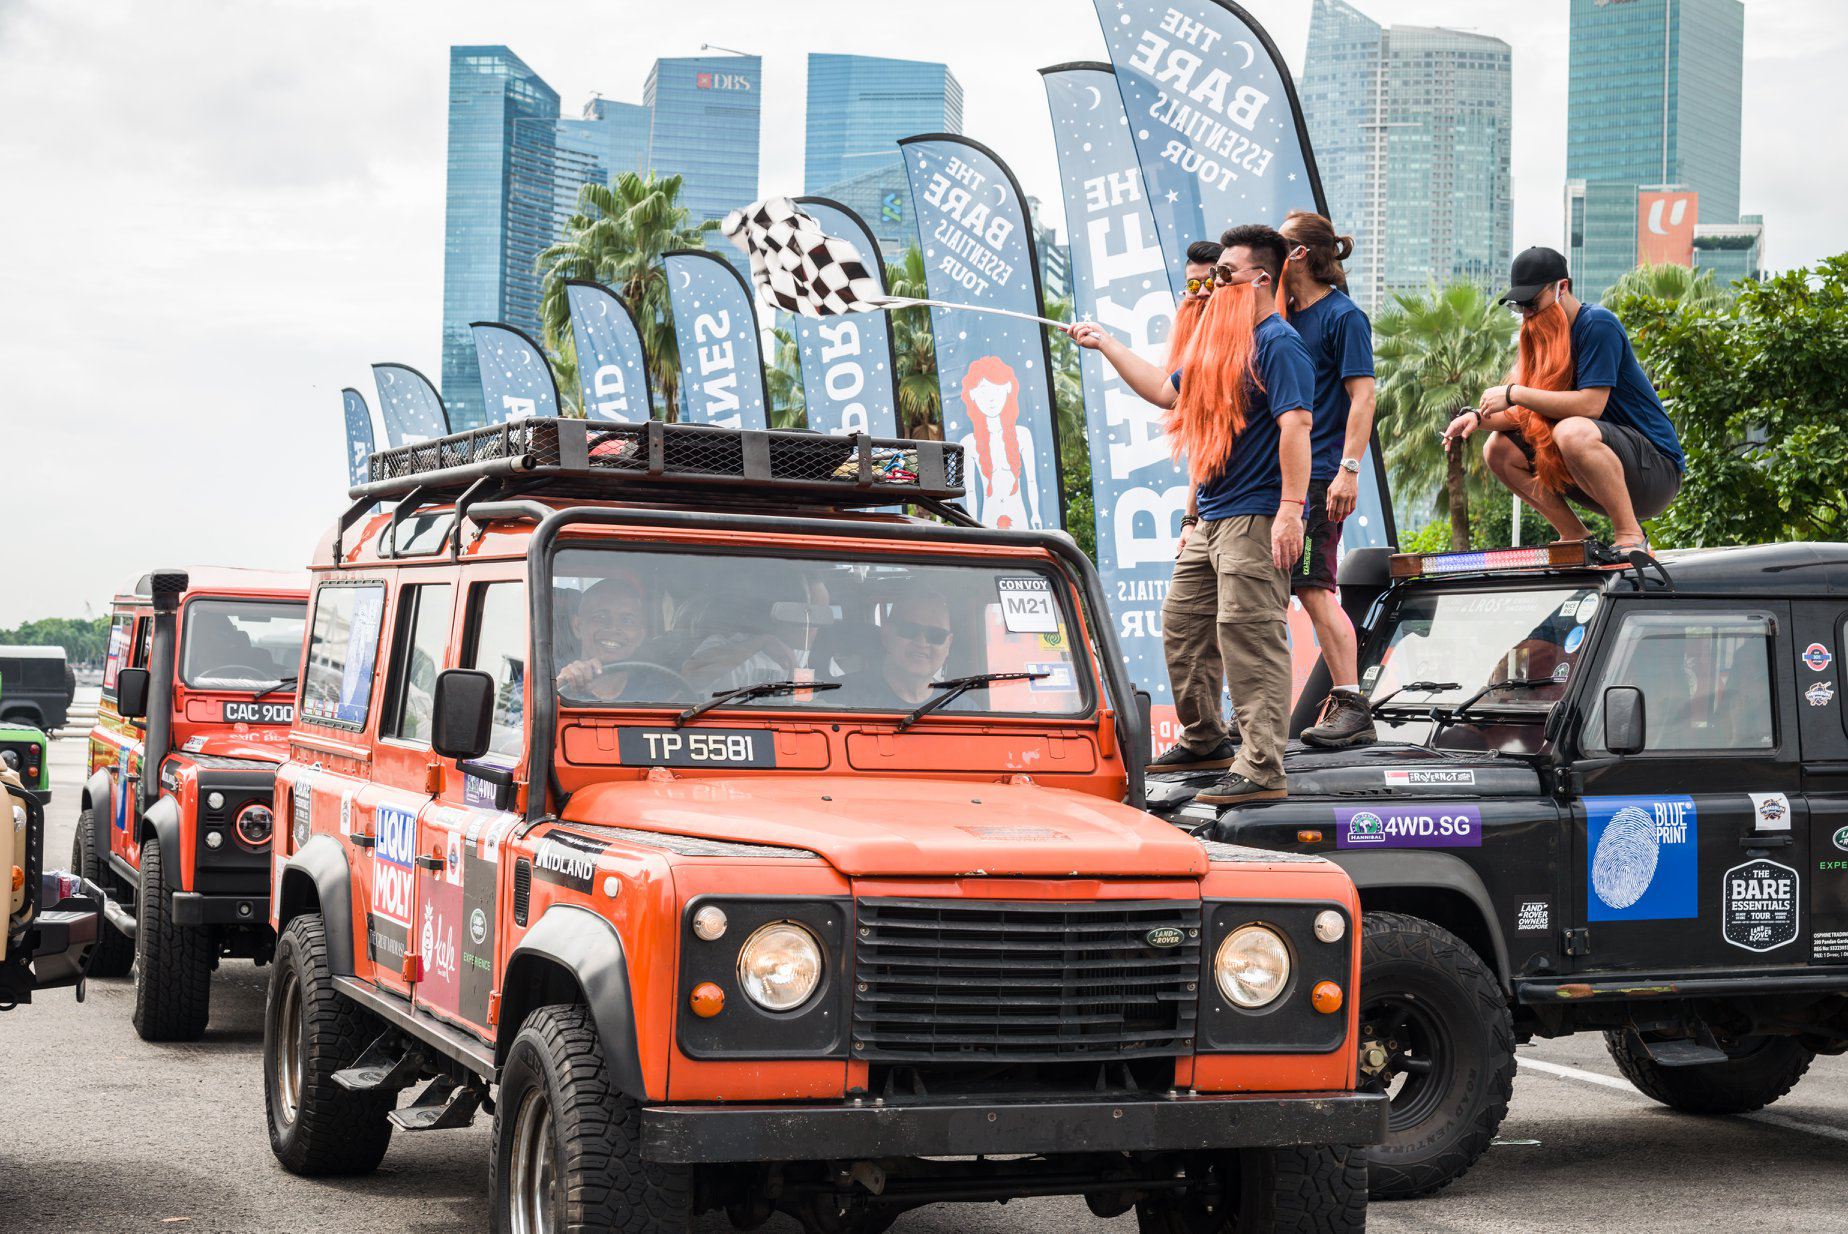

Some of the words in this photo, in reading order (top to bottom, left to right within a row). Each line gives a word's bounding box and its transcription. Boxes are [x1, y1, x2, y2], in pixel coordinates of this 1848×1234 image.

[714, 74, 750, 90] DBS
[999, 580, 1048, 590] CONVOY
[1007, 598, 1049, 614] M21
[226, 704, 259, 720] CAC
[643, 733, 682, 759] TP
[689, 735, 753, 761] 5581
[1654, 802, 1687, 826] BLUE
[376, 804, 416, 864] LIQUI
[1384, 816, 1470, 836] 4WD.SG
[1656, 826, 1687, 844] PRINT
[1753, 870, 1770, 878] THE
[374, 865, 412, 921] MOLY
[1731, 879, 1791, 900] BARE
[1731, 901, 1790, 911] ESSENTIALS
[1155, 930, 1174, 938] LAND
[463, 952, 491, 971] EXPERIENCE
